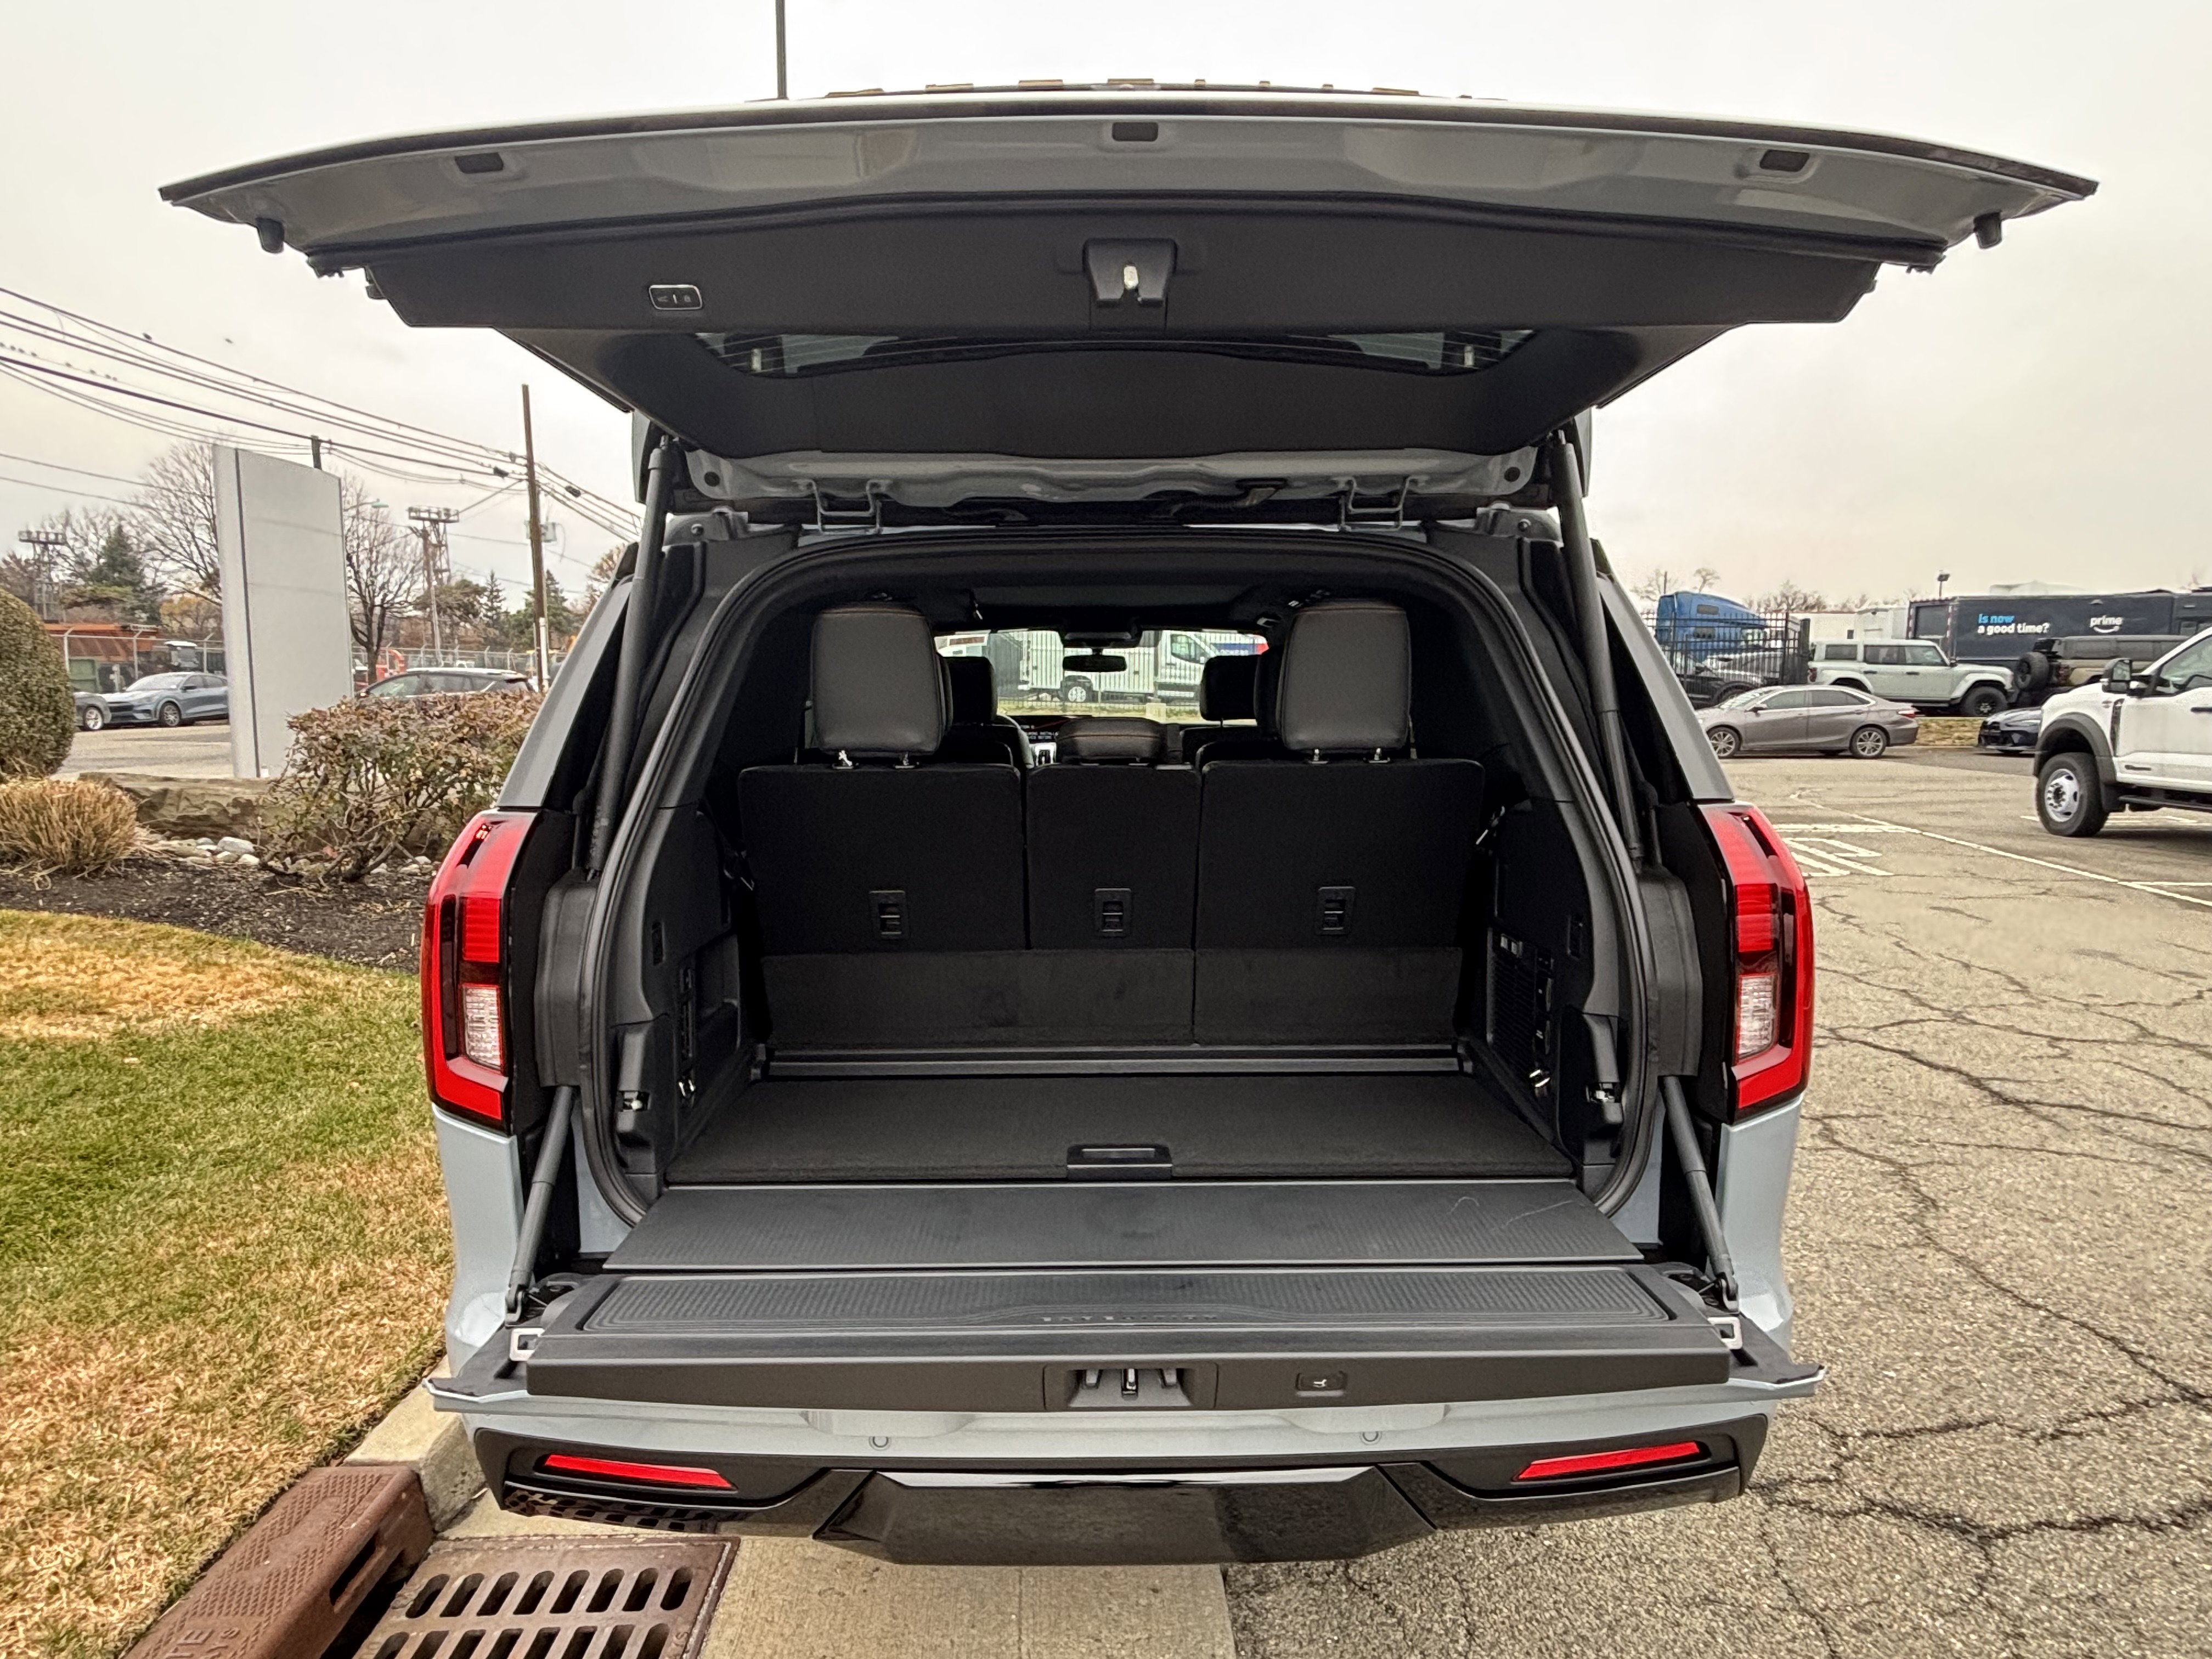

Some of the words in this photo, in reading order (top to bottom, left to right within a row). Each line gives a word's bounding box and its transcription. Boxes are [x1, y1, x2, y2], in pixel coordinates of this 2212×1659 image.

[1990, 615, 2015, 623] now
[2089, 614, 2124, 628] prime
[1977, 625, 1985, 633] a
[1986, 623, 2016, 635] good
[2017, 622, 2051, 633] time?
